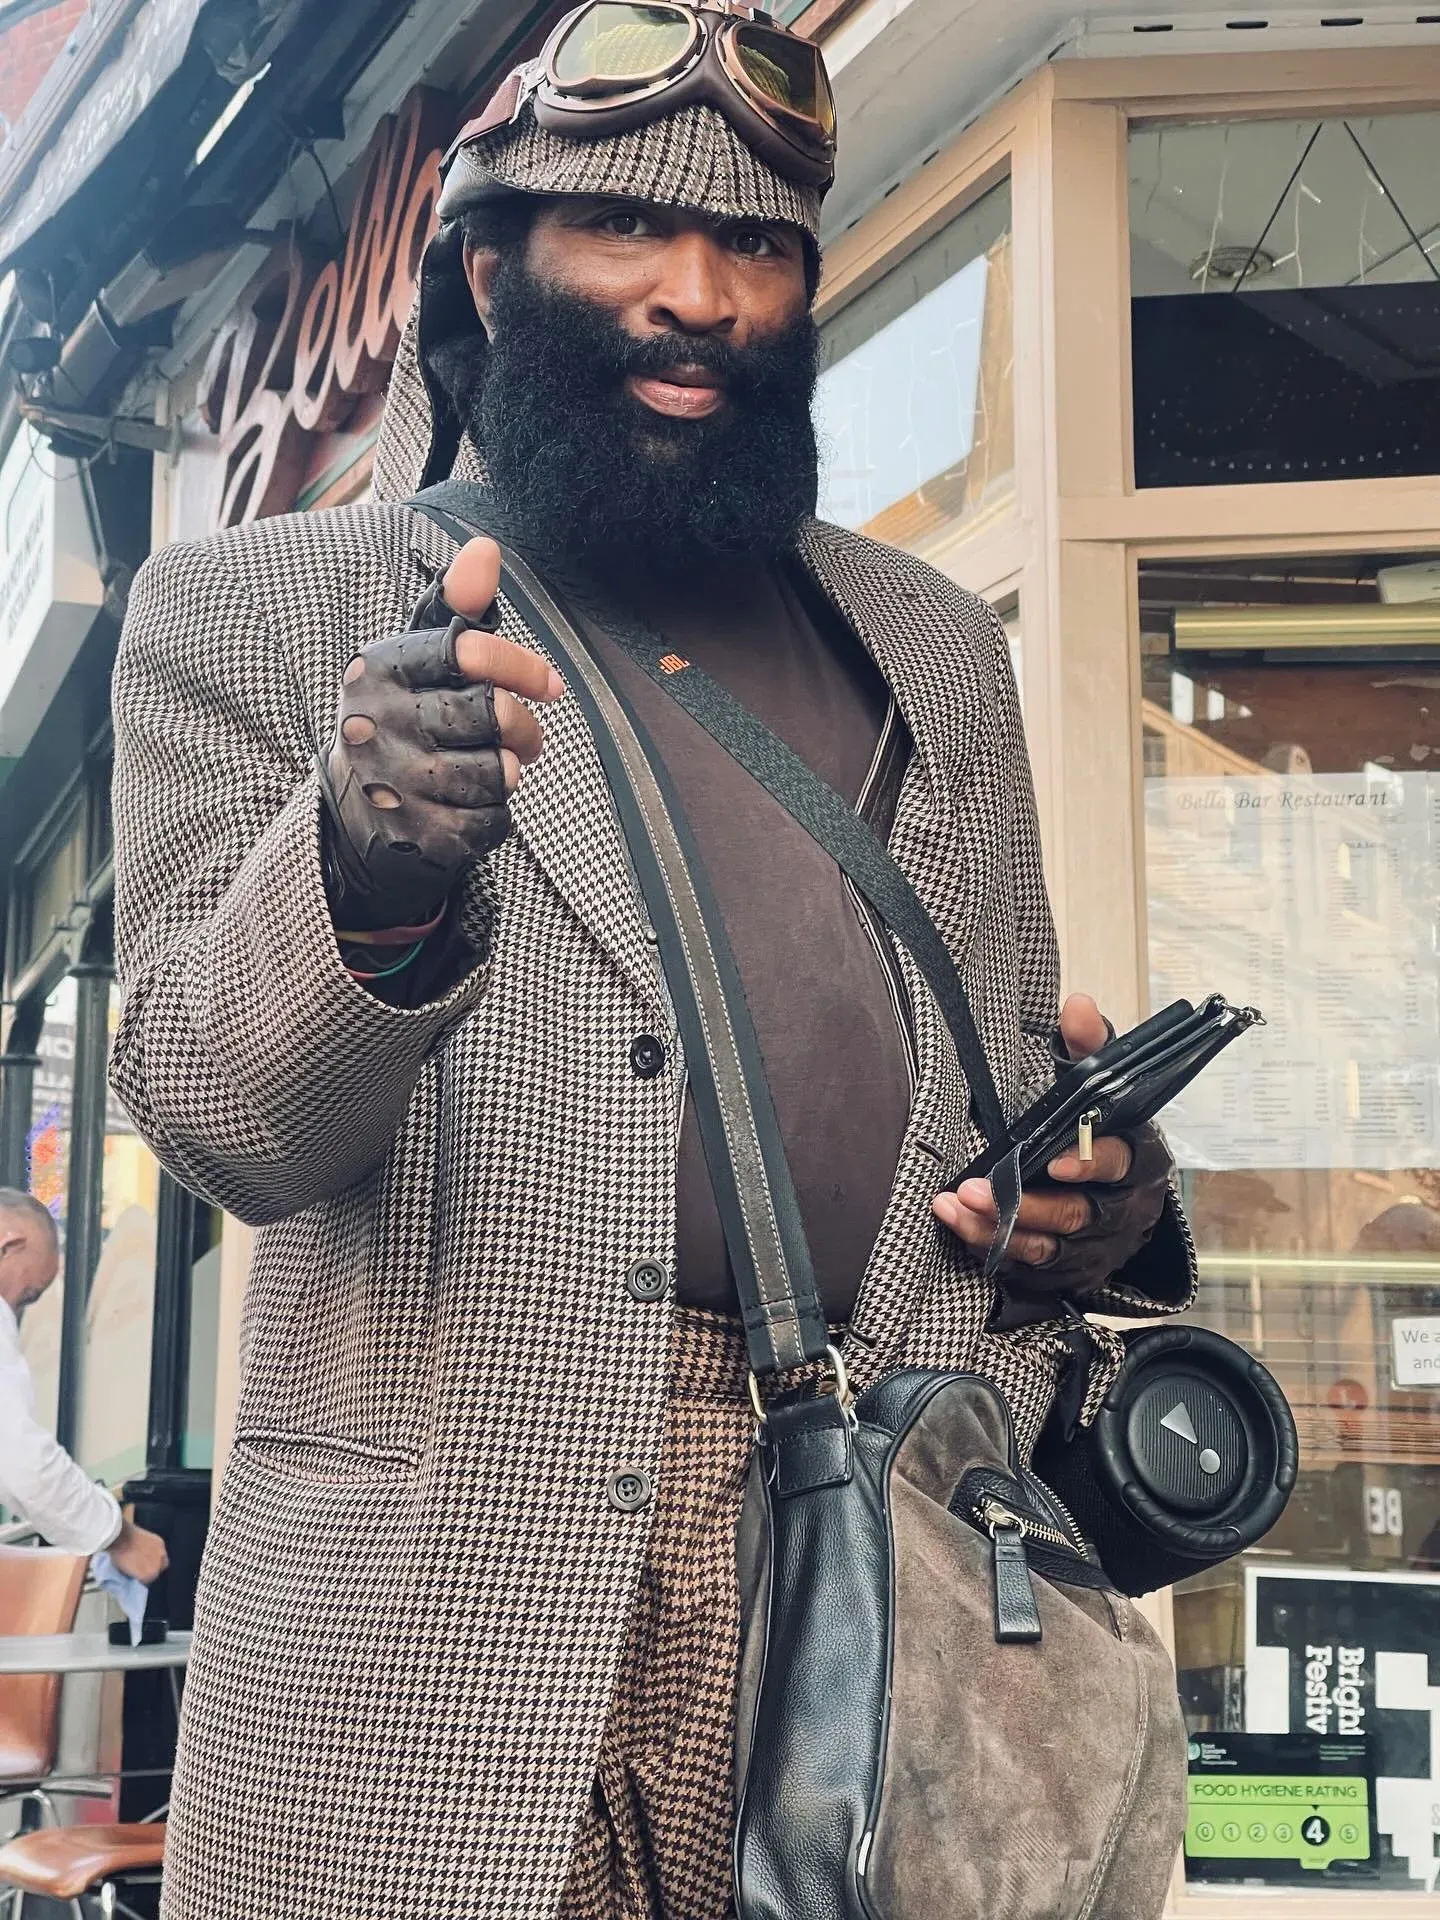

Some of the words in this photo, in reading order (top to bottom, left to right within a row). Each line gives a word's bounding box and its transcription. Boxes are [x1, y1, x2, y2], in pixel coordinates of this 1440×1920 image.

[659, 653, 691, 675] JBL
[1178, 789, 1226, 811] Bella
[1232, 791, 1269, 810] Bar
[1279, 789, 1388, 811] Restaurant
[1401, 1329, 1430, 1344] We
[1193, 1783, 1238, 1798] FOOD
[1241, 1783, 1303, 1798] HYGIENE
[1306, 1784, 1358, 1799] RATING
[1305, 1818, 1326, 1843] 4
